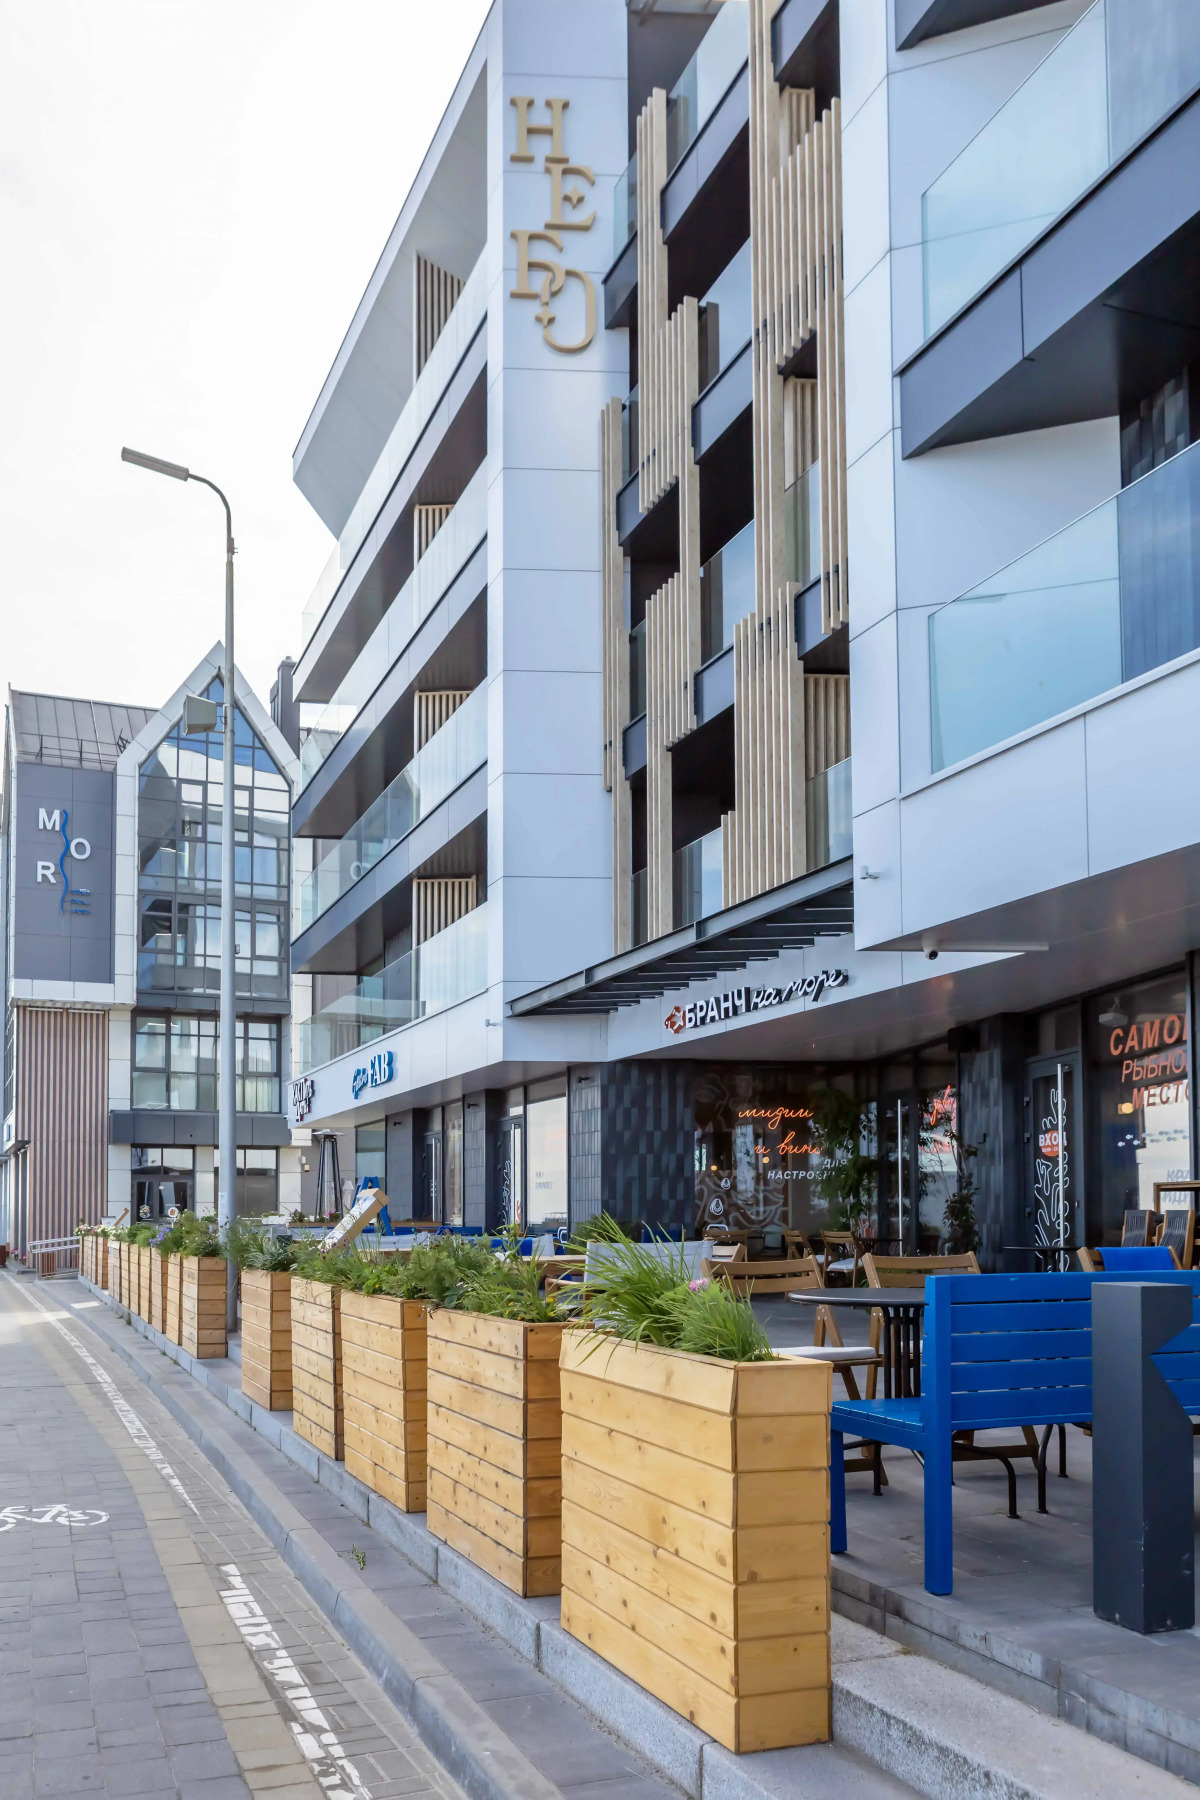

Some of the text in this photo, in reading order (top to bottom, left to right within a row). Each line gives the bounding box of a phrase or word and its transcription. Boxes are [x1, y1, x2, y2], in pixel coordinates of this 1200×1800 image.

[685, 968, 849, 1029] БРАНЧ на море
[1121, 1048, 1188, 1083] РЫБНО
[738, 1107, 814, 1130] мидии
[755, 1144, 771, 1154] и
